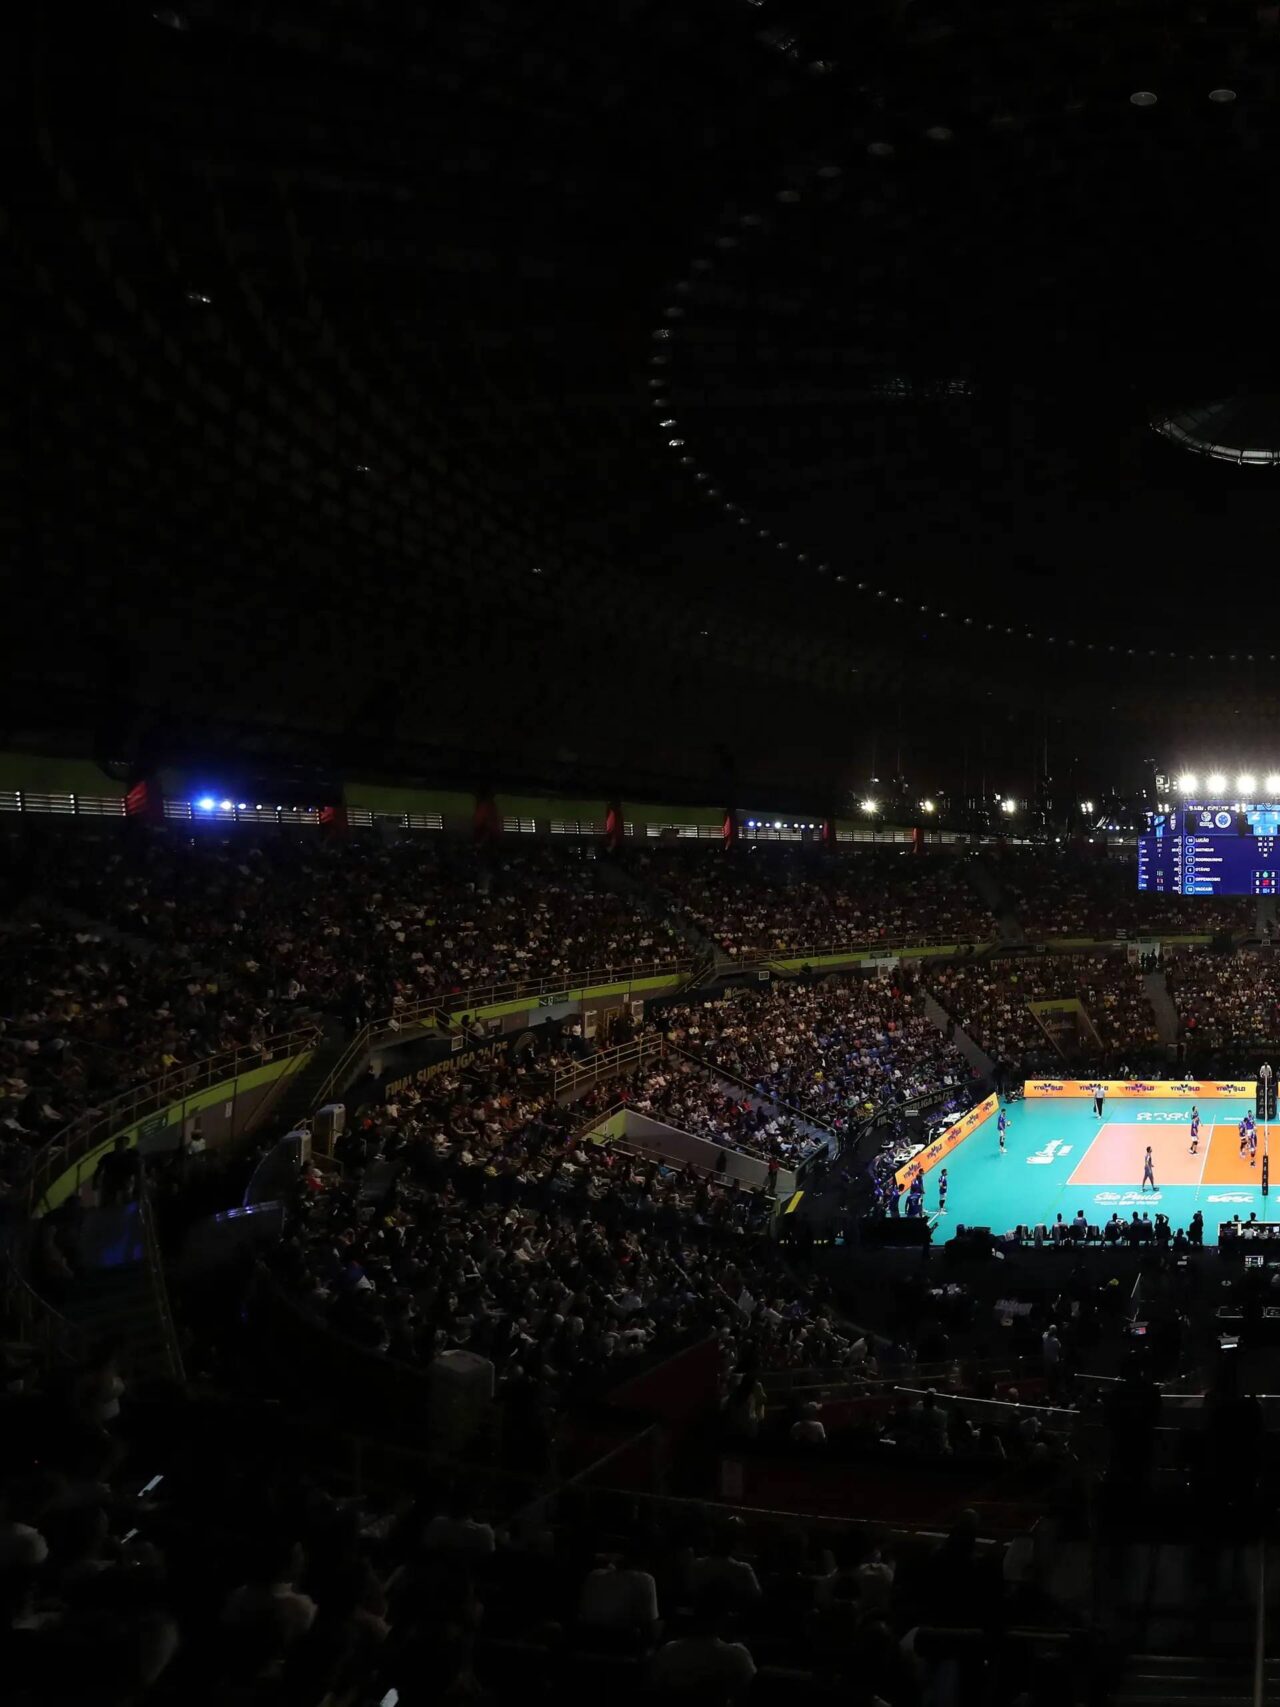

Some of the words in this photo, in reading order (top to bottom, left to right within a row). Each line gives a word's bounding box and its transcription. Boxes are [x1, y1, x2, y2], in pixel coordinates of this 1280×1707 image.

[416, 1051, 475, 1082] SUPERLIGA
[1136, 1111, 1189, 1119] enel
[1095, 1191, 1121, 1201] São
[1121, 1191, 1162, 1201] Paulo
